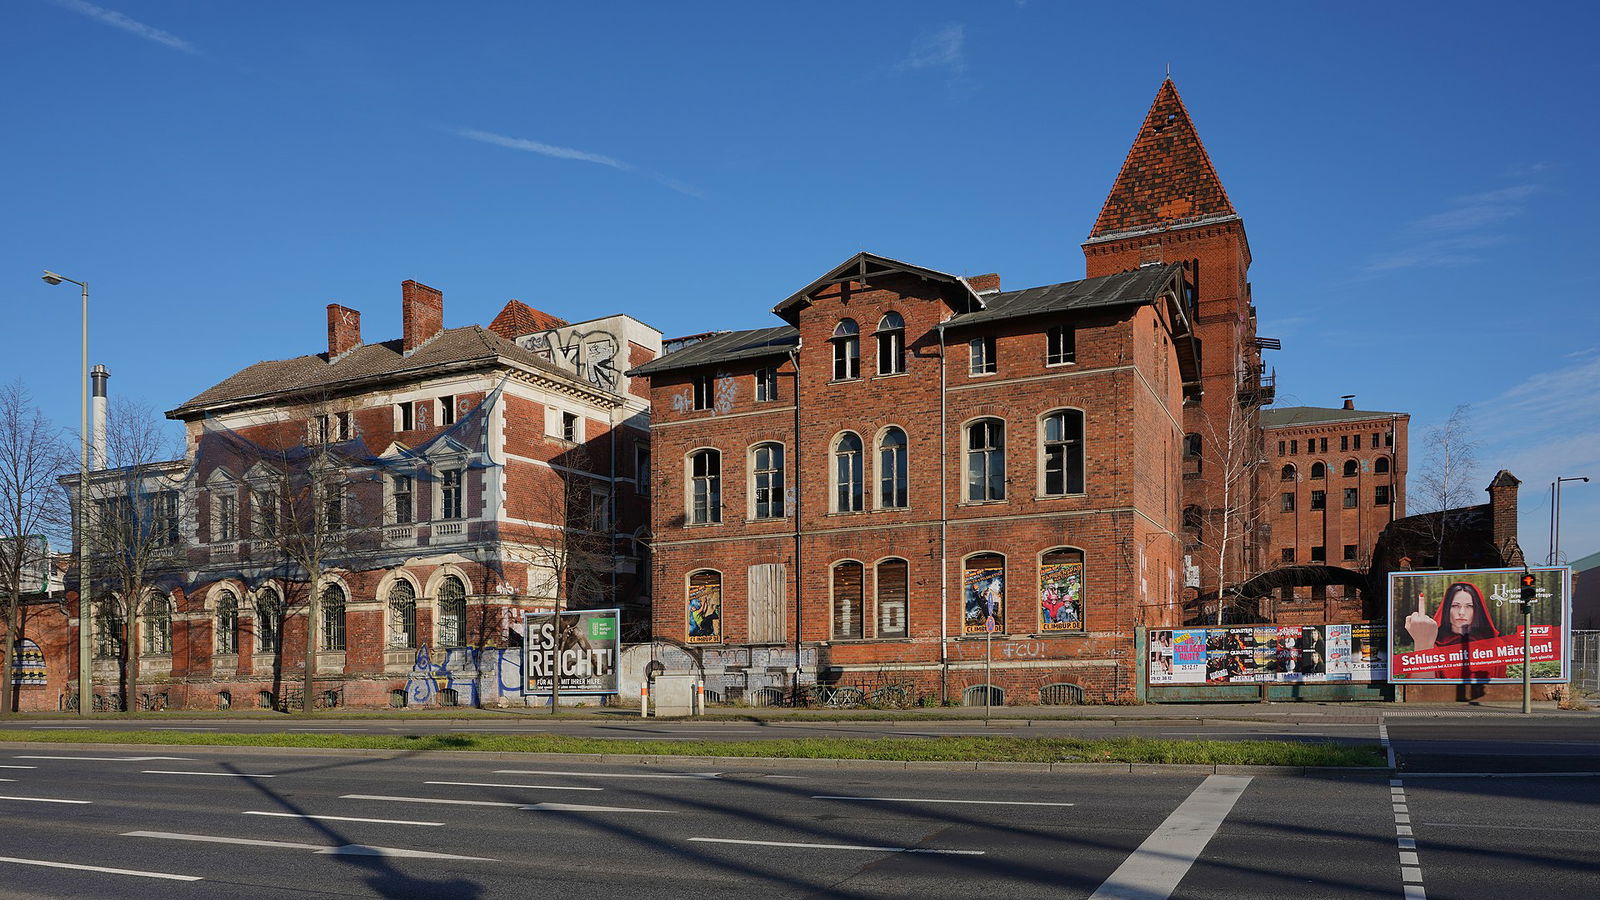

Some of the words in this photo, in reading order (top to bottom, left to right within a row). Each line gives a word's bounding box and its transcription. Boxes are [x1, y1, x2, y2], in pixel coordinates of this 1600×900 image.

[528, 623, 555, 650] ES
[1174, 644, 1206, 652] SCHLAGER
[1402, 653, 1446, 666] Schluss
[1450, 649, 1469, 662] mit
[1473, 648, 1494, 659] den
[528, 648, 613, 677] REICHT!
